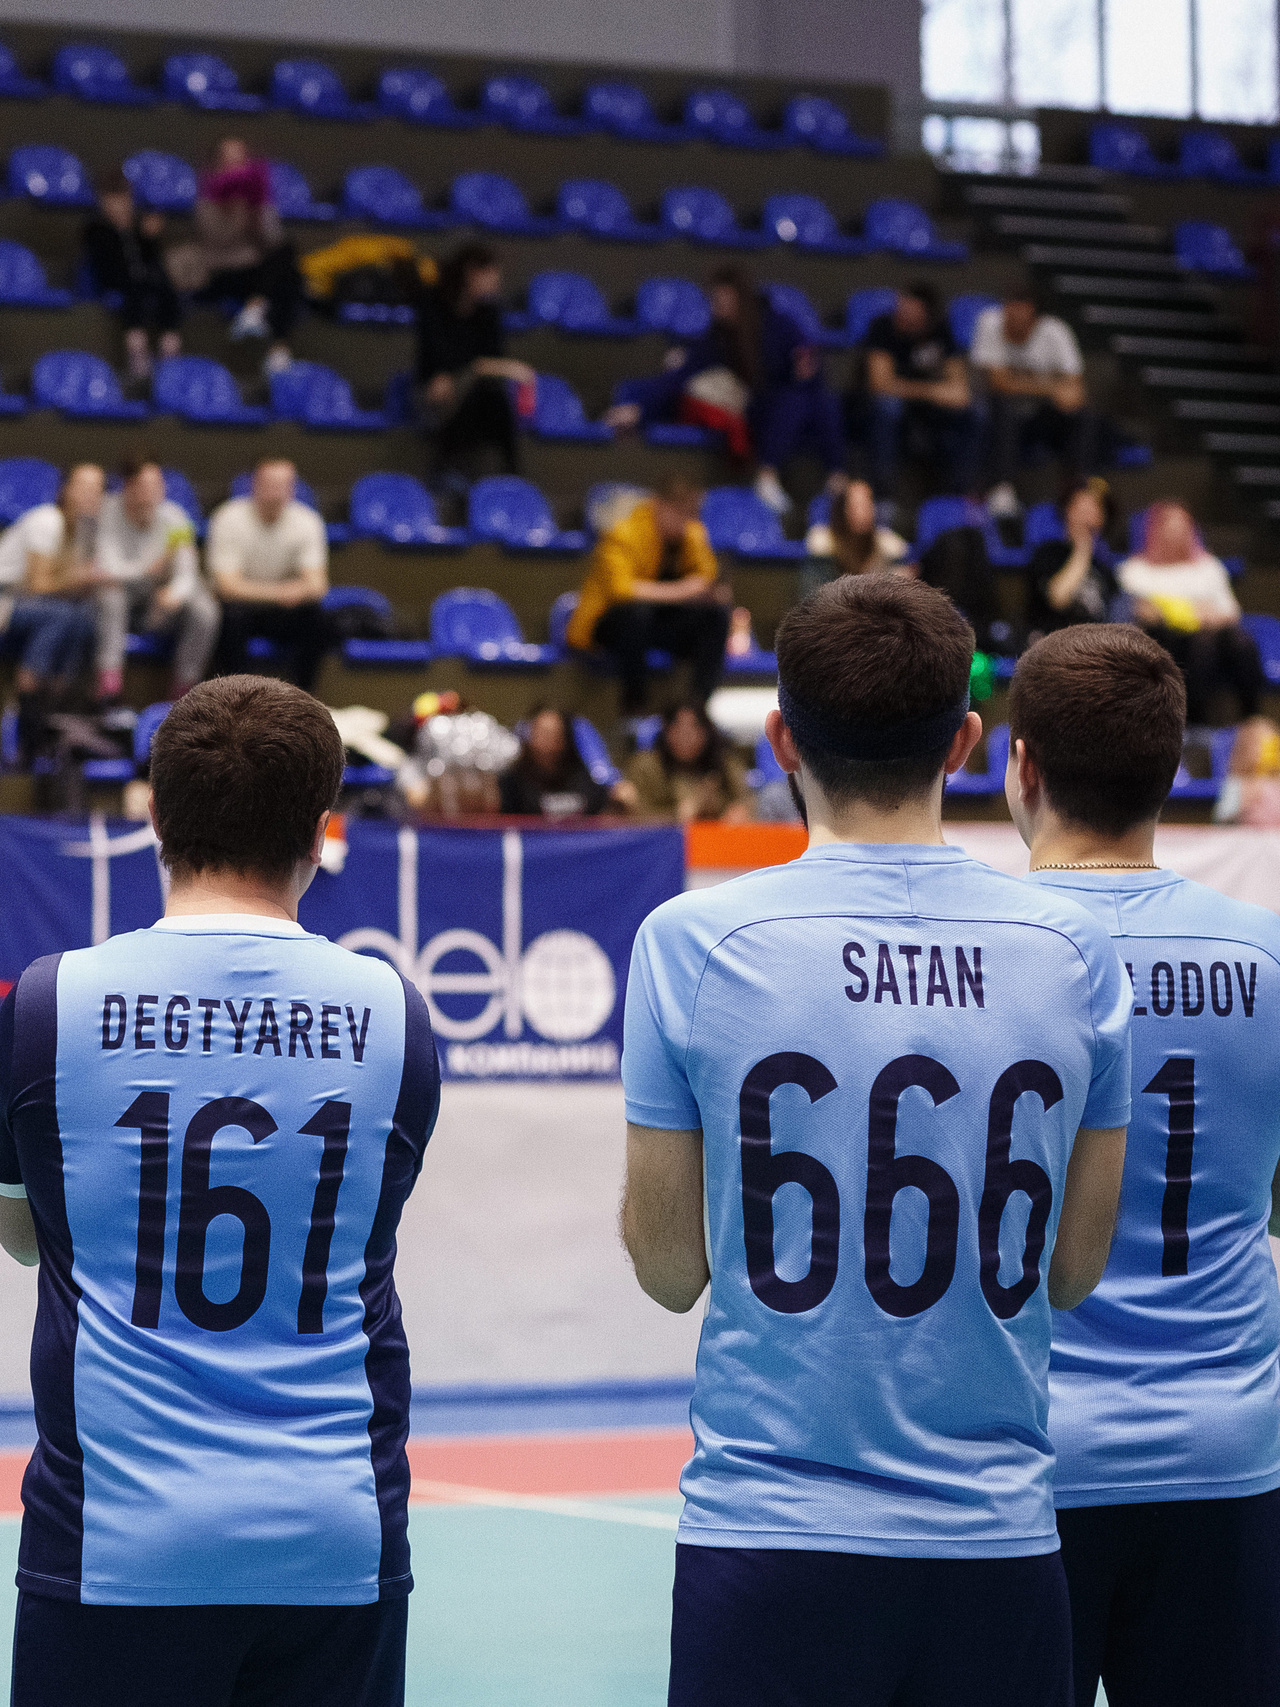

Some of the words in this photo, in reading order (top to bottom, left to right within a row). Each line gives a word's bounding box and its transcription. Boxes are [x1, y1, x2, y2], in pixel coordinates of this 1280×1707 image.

[101, 993, 372, 1064] DEGTYAREV
[842, 941, 985, 1008] SATAN
[113, 1091, 353, 1335] 161
[738, 1051, 1065, 1320] 666
[1140, 1057, 1196, 1278] 1
